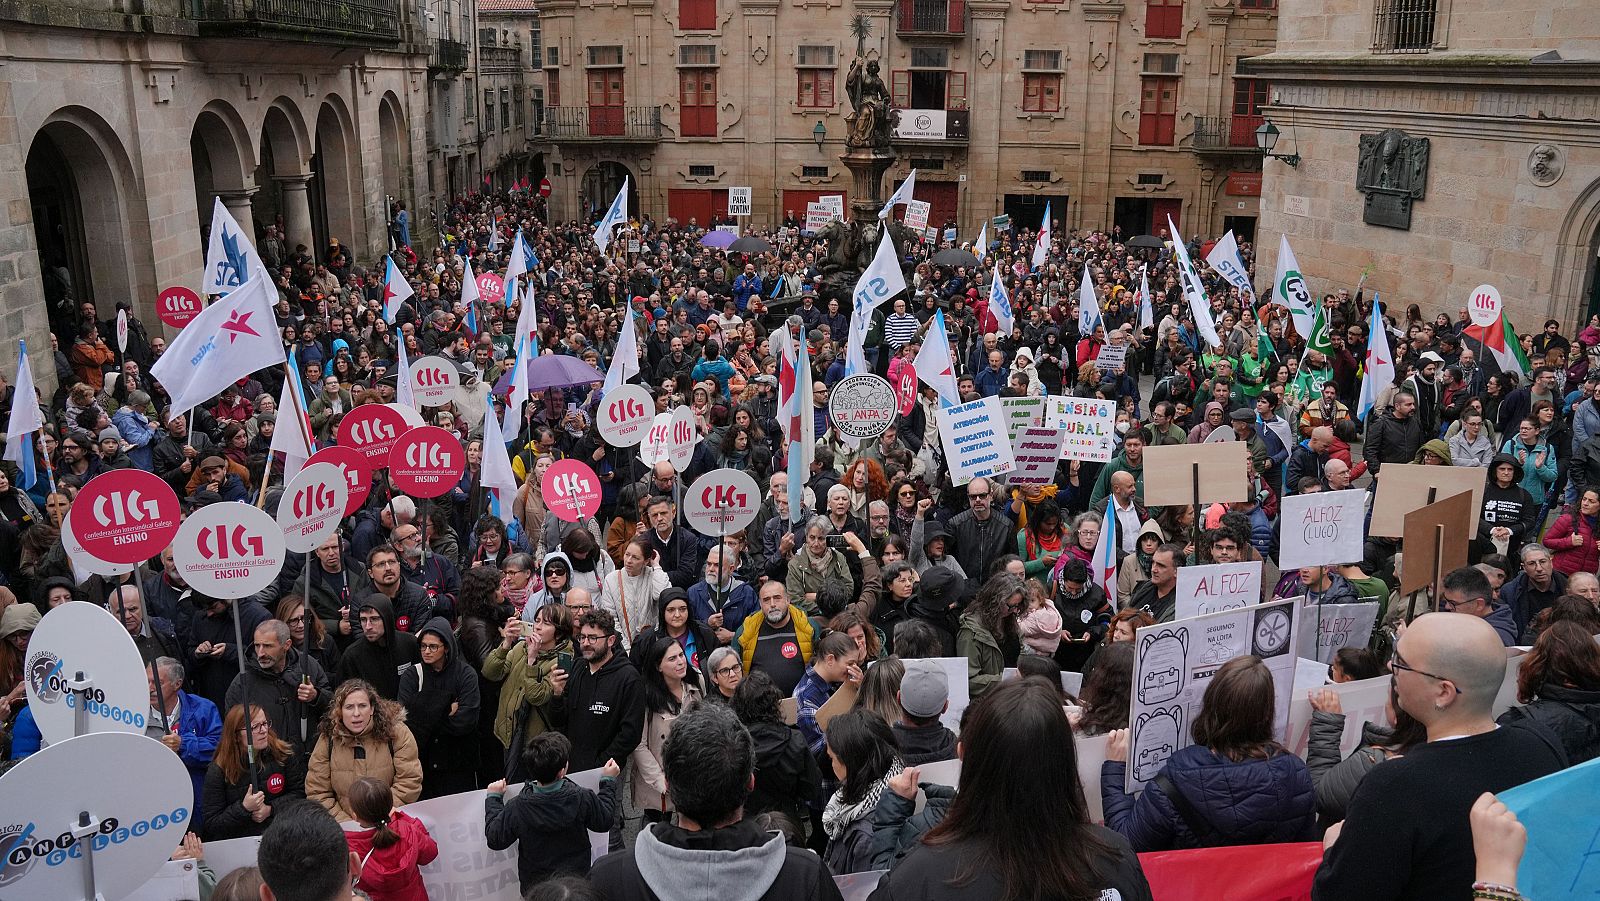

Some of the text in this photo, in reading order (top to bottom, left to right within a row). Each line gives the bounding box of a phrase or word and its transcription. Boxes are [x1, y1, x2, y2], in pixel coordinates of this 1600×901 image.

[166, 295, 195, 312] CIG
[1475, 293, 1495, 310] CIG
[416, 367, 449, 387] CIG
[608, 397, 645, 424] CIG
[947, 401, 986, 416] POR UNHA
[1057, 400, 1108, 417] ENSINO
[350, 417, 396, 445] CIG
[619, 426, 638, 436] ENSINO
[952, 414, 990, 430] ATENCIÓN
[674, 420, 691, 445] CIG
[953, 429, 995, 445] EDUCATIVA
[366, 446, 389, 458] ENSINO
[405, 441, 451, 468] CIG
[414, 475, 439, 483] ENSINO
[553, 472, 591, 497] CIG
[293, 481, 336, 520] CIG
[701, 484, 747, 510] CIG
[93, 488, 161, 528] CIG
[1303, 505, 1343, 523] ALFOZ
[84, 519, 173, 540] Confederación Intersindical Galega
[301, 520, 325, 537] ENSINO
[1303, 521, 1339, 545] (LUGO)
[113, 531, 149, 546] ENSINO
[196, 523, 264, 560] CIG
[185, 557, 276, 572] Confederación Intersindical Galega
[214, 567, 250, 580] ENSINO
[1194, 572, 1251, 597] ALFOZ
[1206, 622, 1236, 634] SEGUIMOS
[1314, 616, 1356, 634] ALFOZ
[1216, 633, 1233, 642] LOITA
[50, 676, 105, 704] ANAS
[66, 693, 145, 728] GLEGAS
[270, 777, 282, 786] CIG
[8, 817, 119, 866] ANPS
